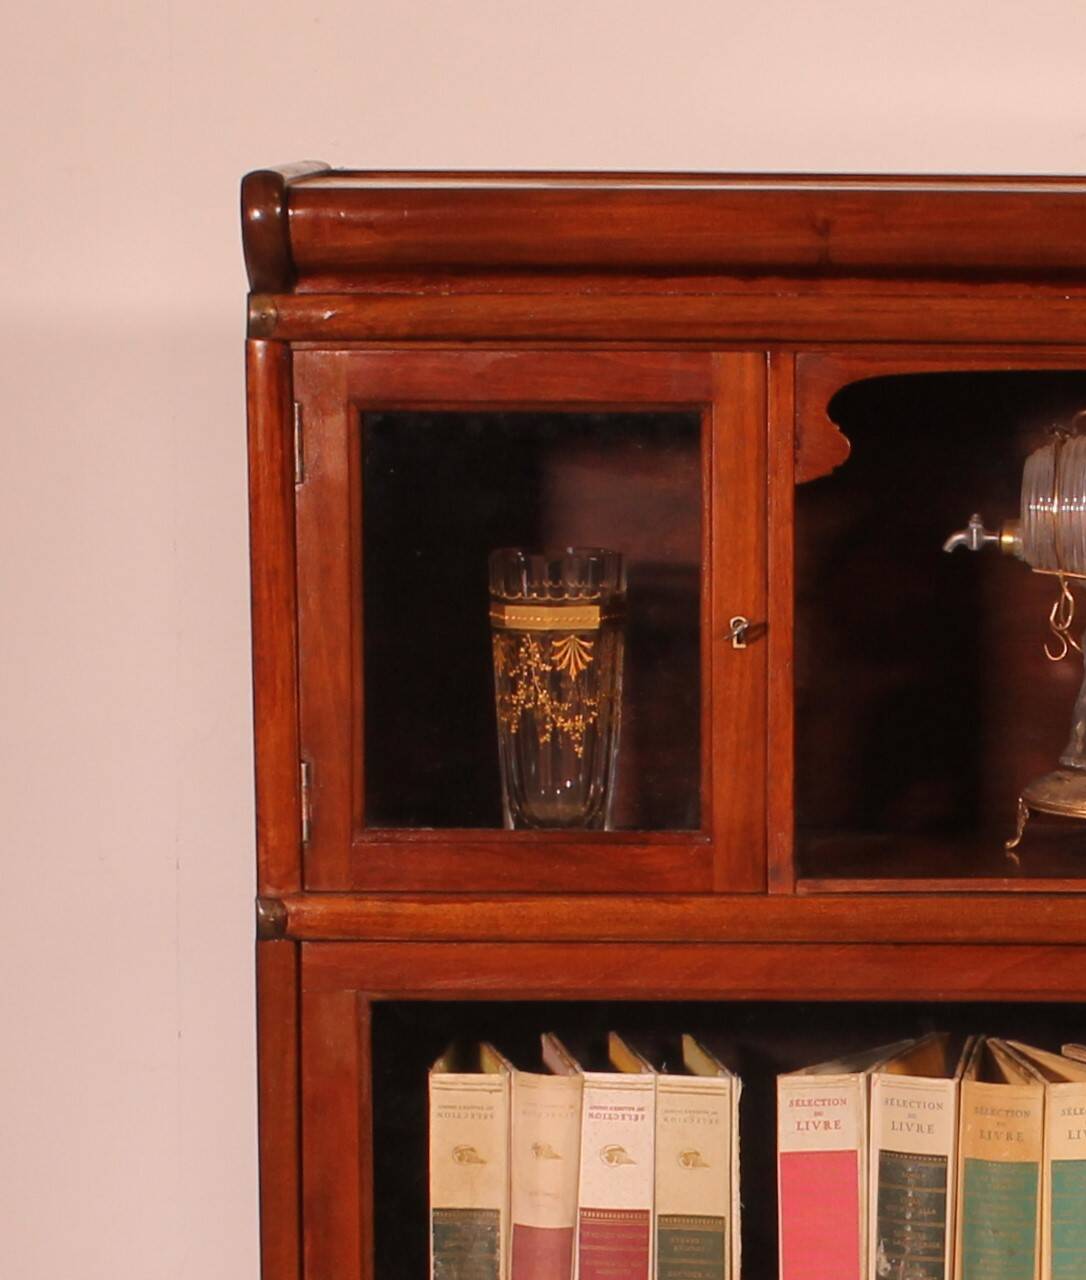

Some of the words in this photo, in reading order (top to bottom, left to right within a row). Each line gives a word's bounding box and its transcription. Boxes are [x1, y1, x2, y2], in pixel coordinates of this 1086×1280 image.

[789, 1096, 847, 1109] SÉLECTION
[796, 1119, 842, 1132] LIVRE
[891, 1121, 935, 1134] LIVRE
[979, 1129, 1024, 1142] LIVRE
